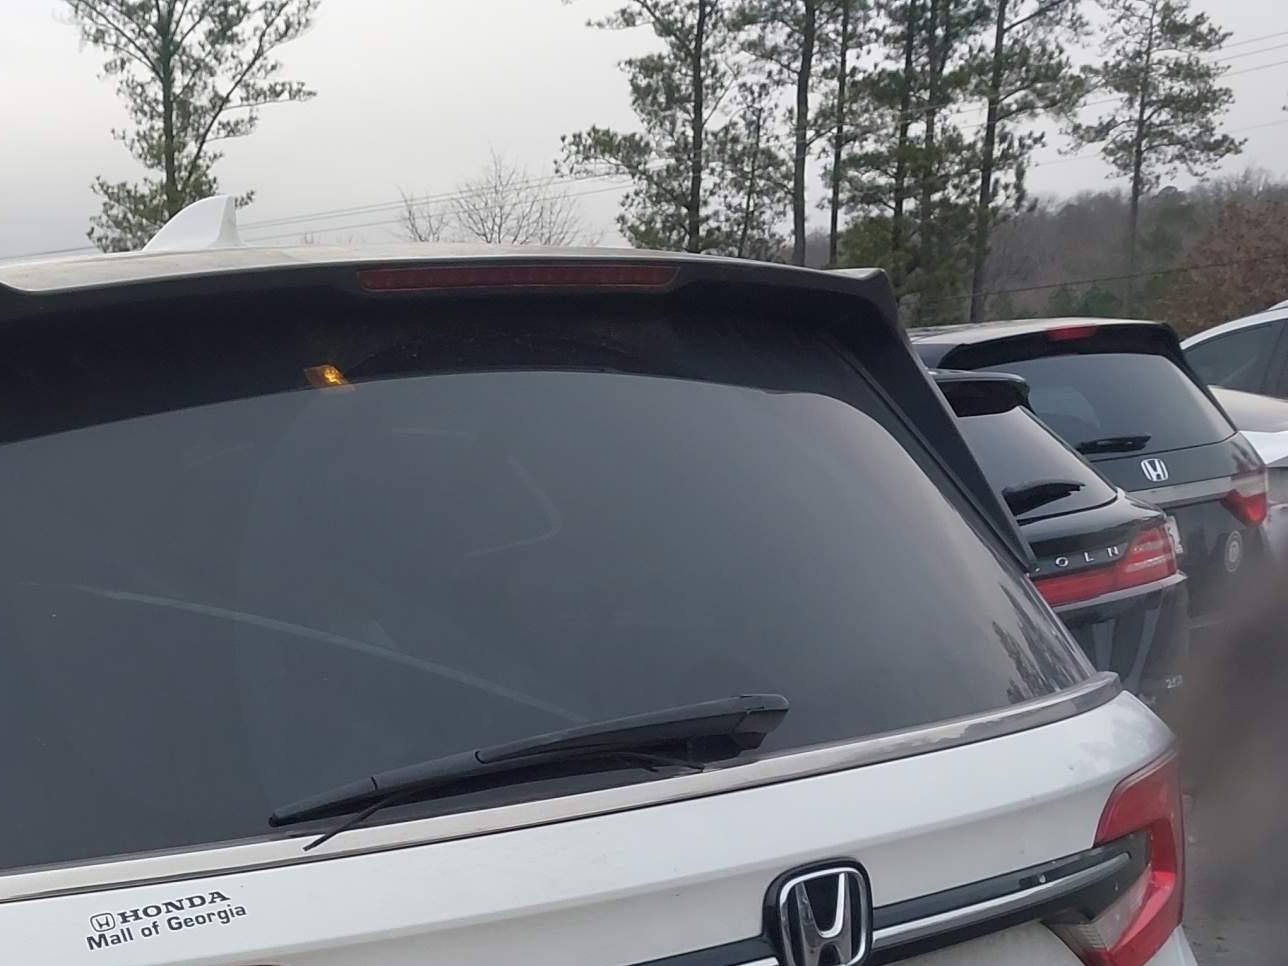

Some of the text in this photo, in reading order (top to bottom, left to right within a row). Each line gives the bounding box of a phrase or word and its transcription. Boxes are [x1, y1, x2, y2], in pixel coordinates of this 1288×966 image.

[86, 904, 247, 951] Mall of Georgia
[117, 891, 231, 924] HONDA
